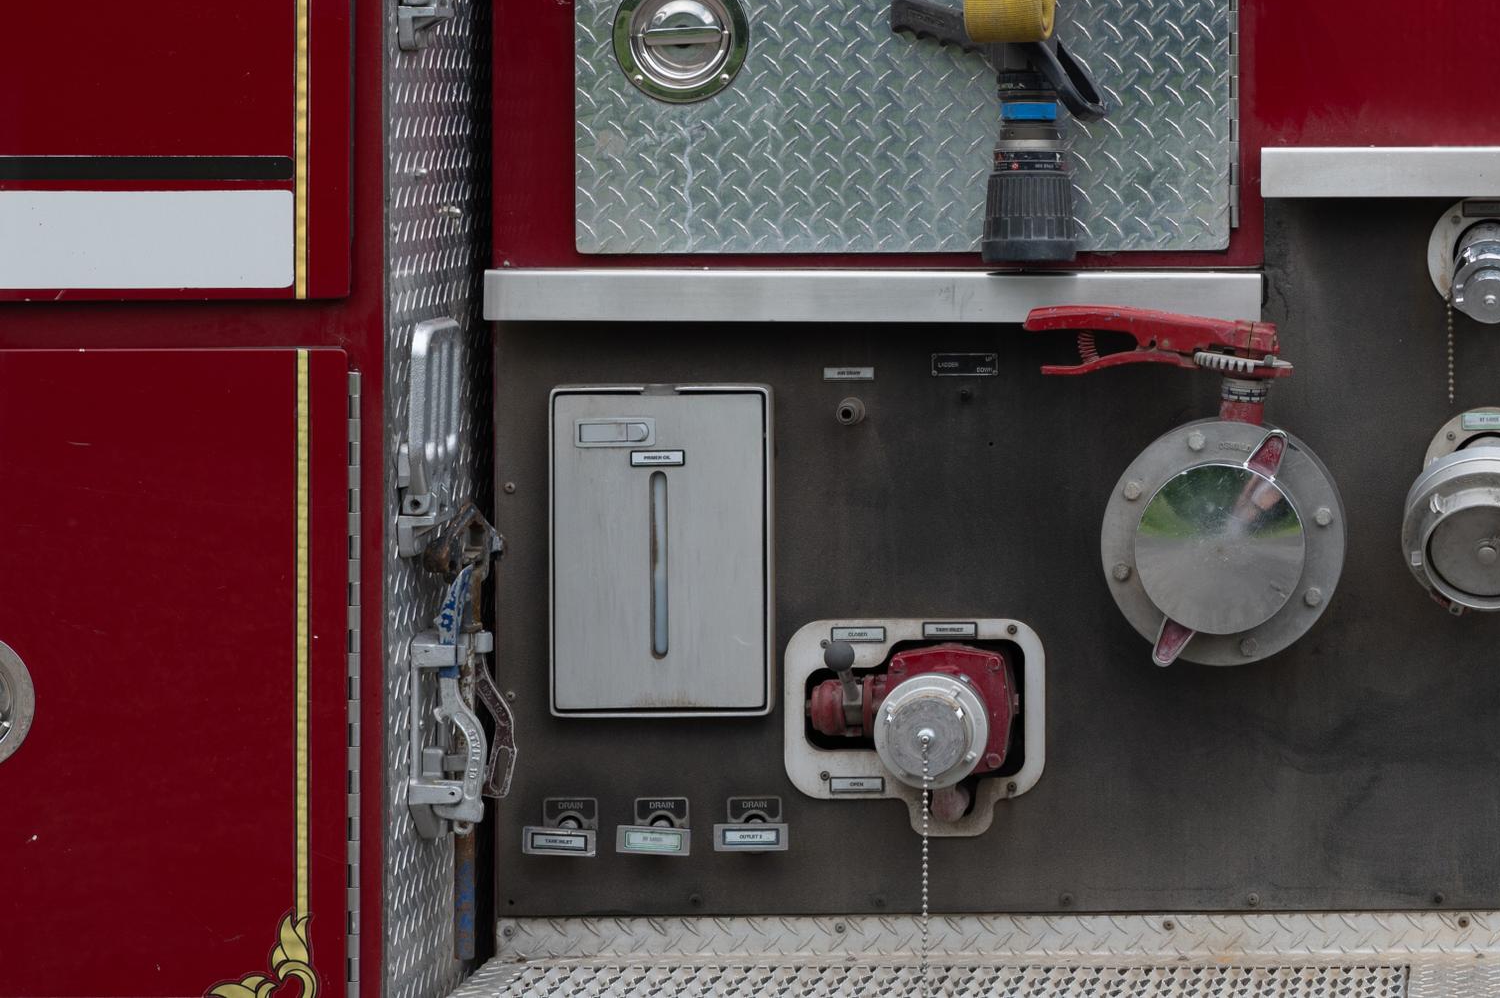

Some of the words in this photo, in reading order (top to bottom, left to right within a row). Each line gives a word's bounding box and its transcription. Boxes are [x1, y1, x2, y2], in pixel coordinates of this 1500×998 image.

[558, 801, 584, 810] DRAIN
[649, 801, 675, 809] DRAIN
[742, 801, 768, 809] DRAIN
